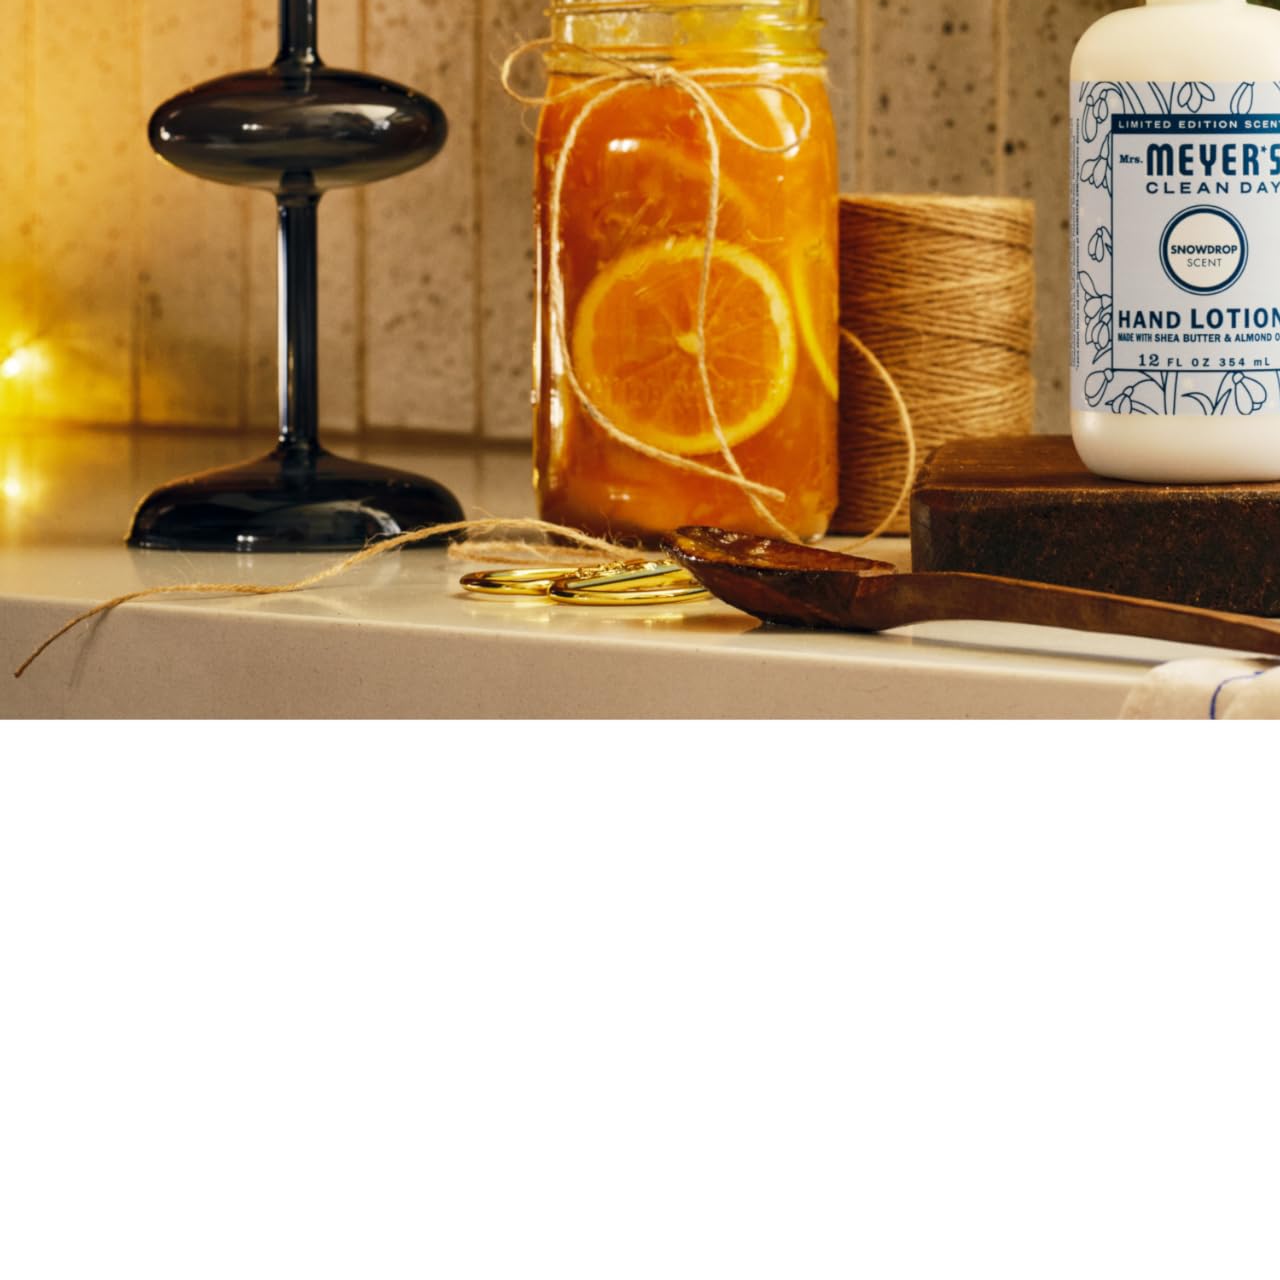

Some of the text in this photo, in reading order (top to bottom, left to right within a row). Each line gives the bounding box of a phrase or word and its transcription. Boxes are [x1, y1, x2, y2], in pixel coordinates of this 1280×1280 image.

[1118, 120, 1172, 129] LIMITED
[1179, 120, 1237, 128] EDITION
[1119, 154, 1143, 164] Mrs.
[1146, 182, 1280, 194] CLEAN DAY
[1171, 245, 1237, 254] SNOWDROP
[1187, 258, 1222, 268] SCENT
[1119, 310, 1180, 329] HAND
[1118, 333, 1134, 342] MADE
[1136, 333, 1152, 342] WITH
[1155, 334, 1179, 342] SHEA
[1183, 334, 1220, 342] BUTTER
[1224, 334, 1231, 342] &
[1235, 333, 1272, 342] ALMOND
[1139, 354, 1270, 367] 12 FL OZ 354 mL
